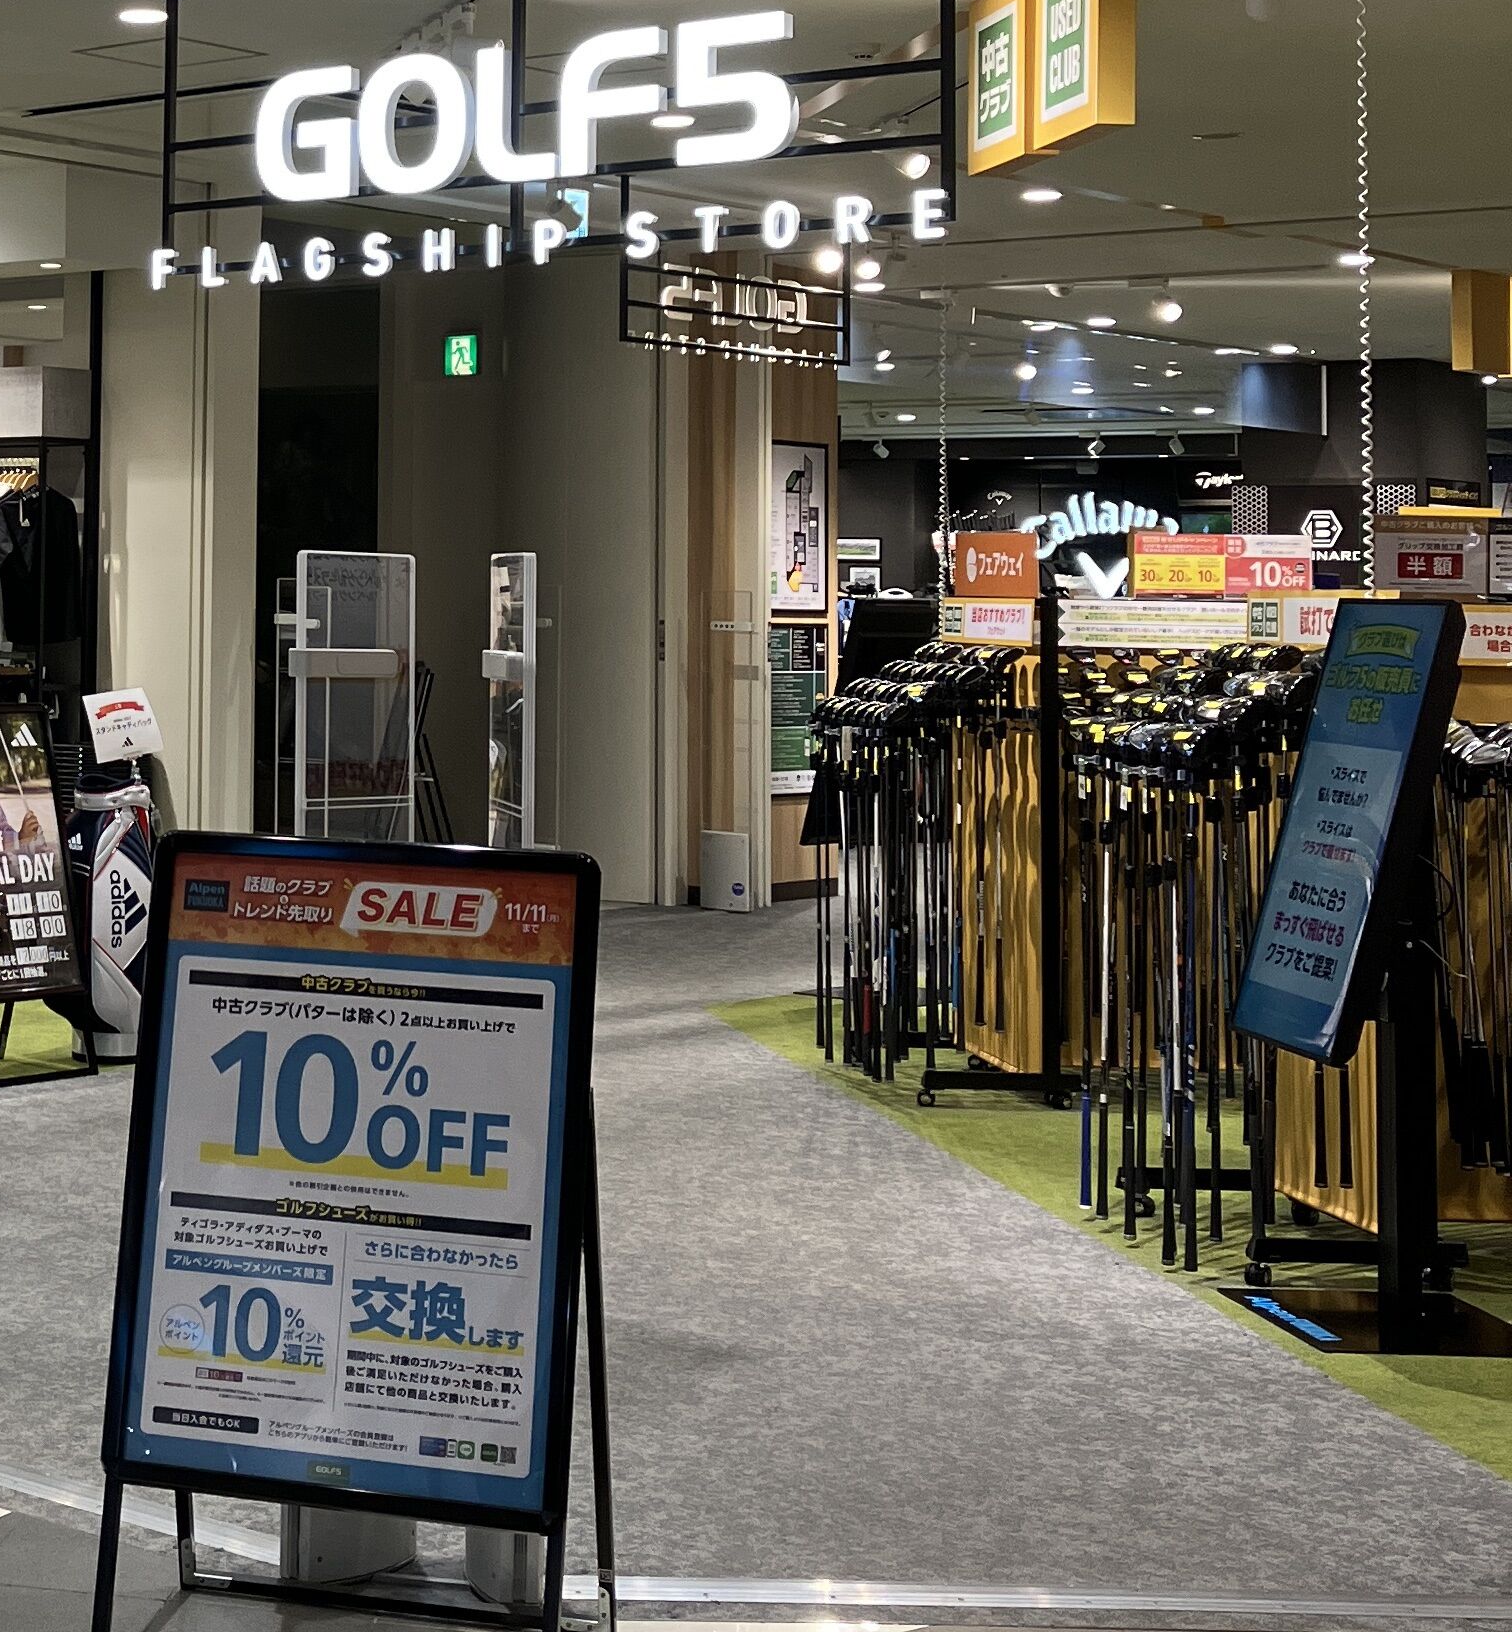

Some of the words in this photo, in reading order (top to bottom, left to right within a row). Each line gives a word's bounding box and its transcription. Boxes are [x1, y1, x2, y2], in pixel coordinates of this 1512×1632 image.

[981, 31, 1010, 82] 中古
[1049, 43, 1081, 94] CLUB
[255, 10, 799, 202] GOLF5
[979, 78, 1012, 124] クラブ
[150, 216, 567, 291] FLAGSHIP
[625, 187, 950, 259] STORE
[978, 551, 1024, 577] フェアウェイ
[1406, 555, 1453, 576] 半額
[1281, 575, 1307, 587] OFF
[17, 852, 55, 884] DAY
[189, 882, 226, 896] Alpen
[243, 875, 333, 896] 話題のクラブ
[1288, 880, 1347, 913] あなたに合う
[109, 869, 123, 950] adidas
[233, 901, 333, 923] トレンド先取り
[356, 887, 484, 932] SALE
[521, 924, 539, 935] まで
[1273, 911, 1345, 948] まっすぐ飛ばせる
[366, 1102, 511, 1178] OFF
[365, 1241, 519, 1270] さらに合わなかったら
[165, 1318, 201, 1330] アルペン
[349, 1275, 524, 1350] 交換します
[165, 1330, 199, 1342] ポイント
[283, 1329, 326, 1344] ポイント
[281, 1343, 325, 1368] 還元
